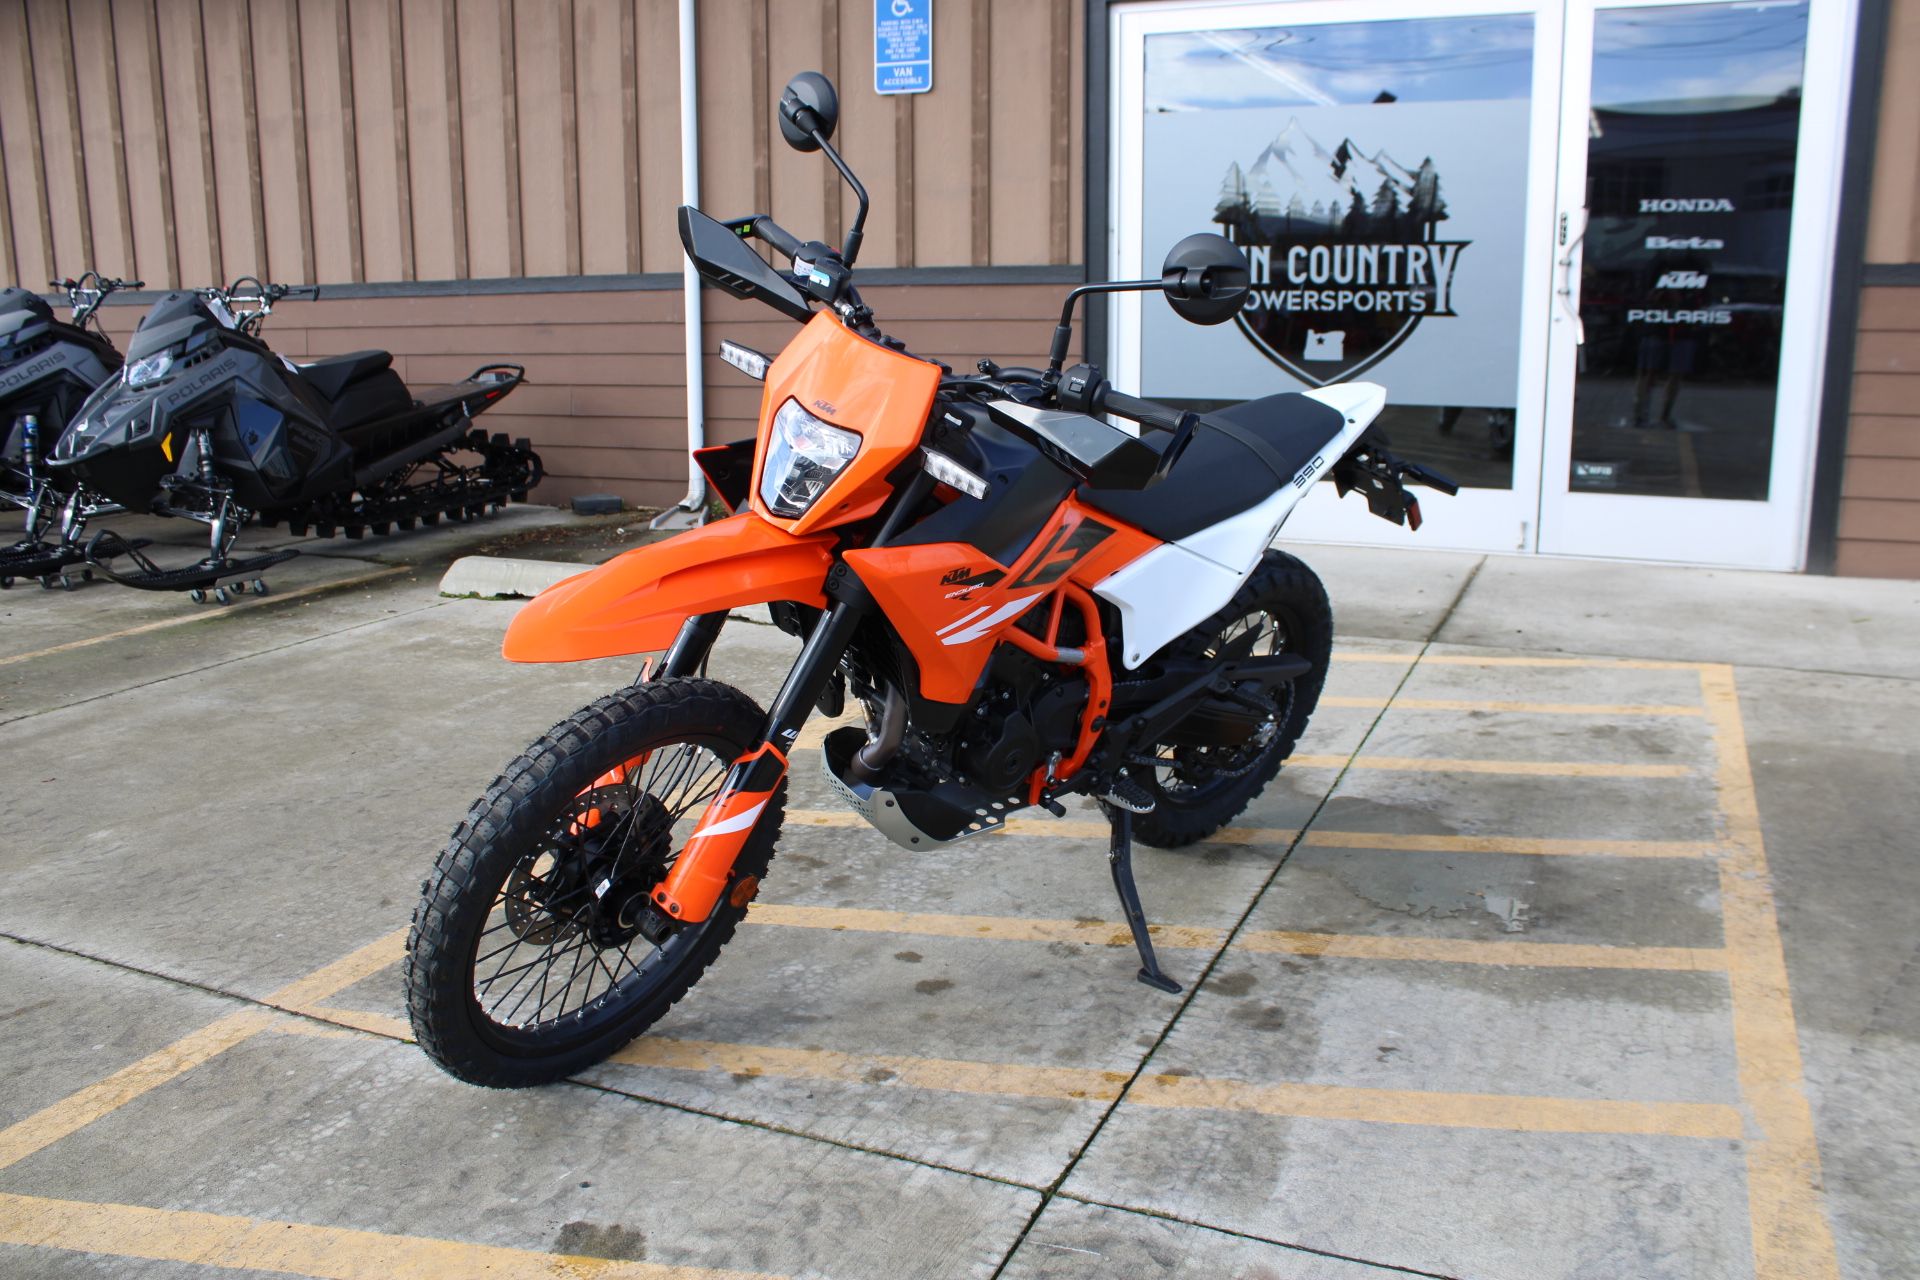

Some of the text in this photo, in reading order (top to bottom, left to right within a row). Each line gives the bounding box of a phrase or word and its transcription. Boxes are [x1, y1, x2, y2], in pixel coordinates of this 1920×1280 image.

[893, 66, 912, 76] VAN
[883, 77, 922, 86] ACCESSIBLE
[1639, 199, 1735, 212] HONDA
[1645, 236, 1724, 249] Beta
[1288, 244, 1461, 313] COUNTRY
[1656, 271, 1709, 289] KTM
[1243, 290, 1427, 313] OWERSPORTS
[1628, 308, 1732, 324] POLARIS
[167, 358, 238, 406] POLARIS
[814, 400, 836, 415] KTM
[1293, 456, 1324, 488] 390
[940, 567, 971, 585] KTM
[944, 582, 984, 599] ENDURO
